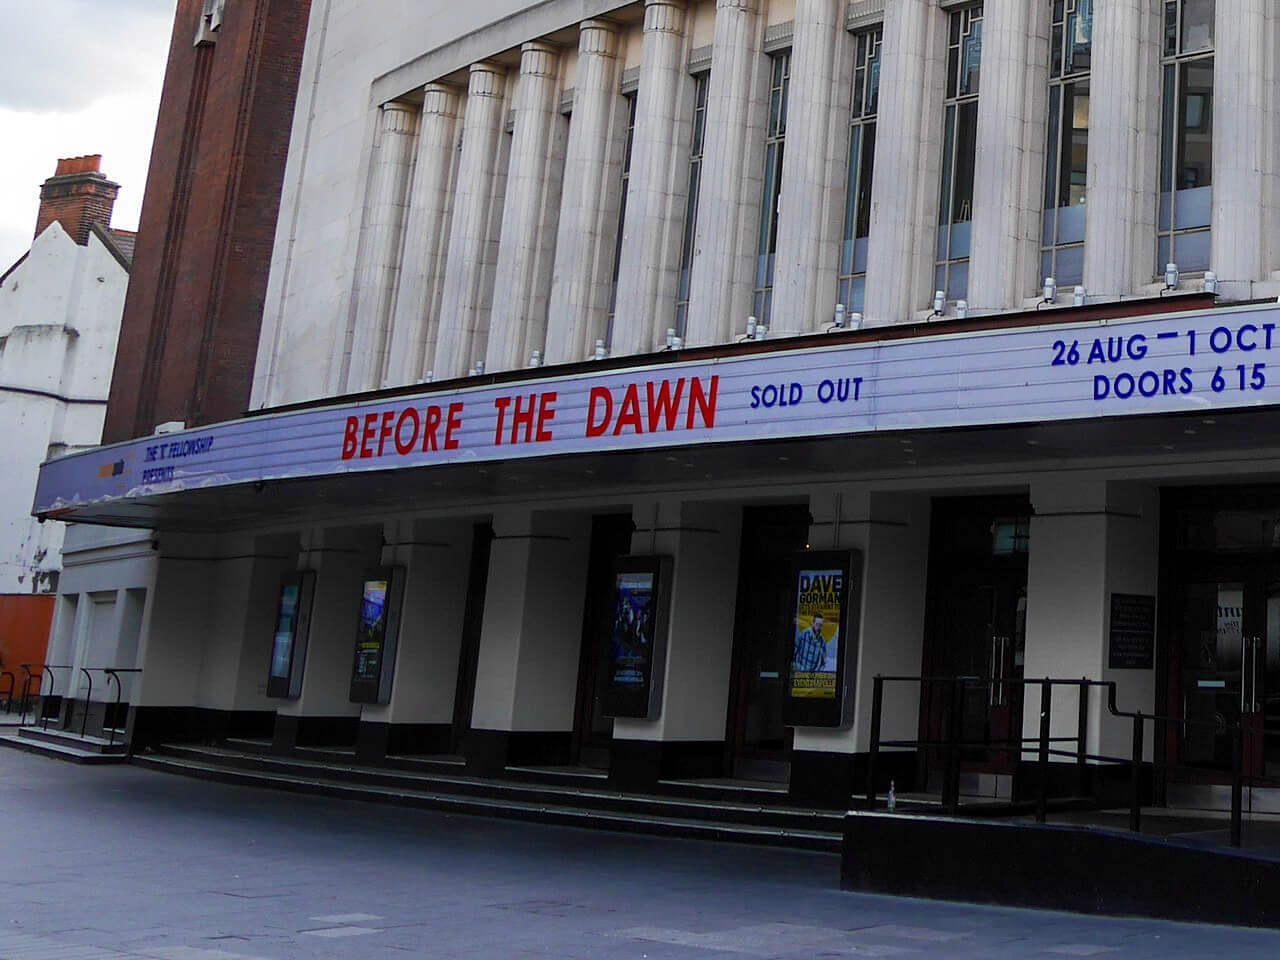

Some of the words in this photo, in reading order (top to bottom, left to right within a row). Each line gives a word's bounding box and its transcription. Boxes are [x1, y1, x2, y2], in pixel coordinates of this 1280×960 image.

[1051, 340, 1080, 366] 26
[1087, 333, 1148, 364] AUG
[1187, 330, 1195, 355] 1
[1210, 323, 1275, 353] OCT
[750, 382, 803, 409] SOLD
[818, 377, 863, 403] OUT
[1093, 367, 1193, 400] DOORS
[341, 402, 463, 460] BEFORE
[494, 391, 557, 446] THE
[586, 375, 719, 438] DAWN
[800, 575, 843, 592] DAVE
[800, 592, 841, 604] GORMAN
